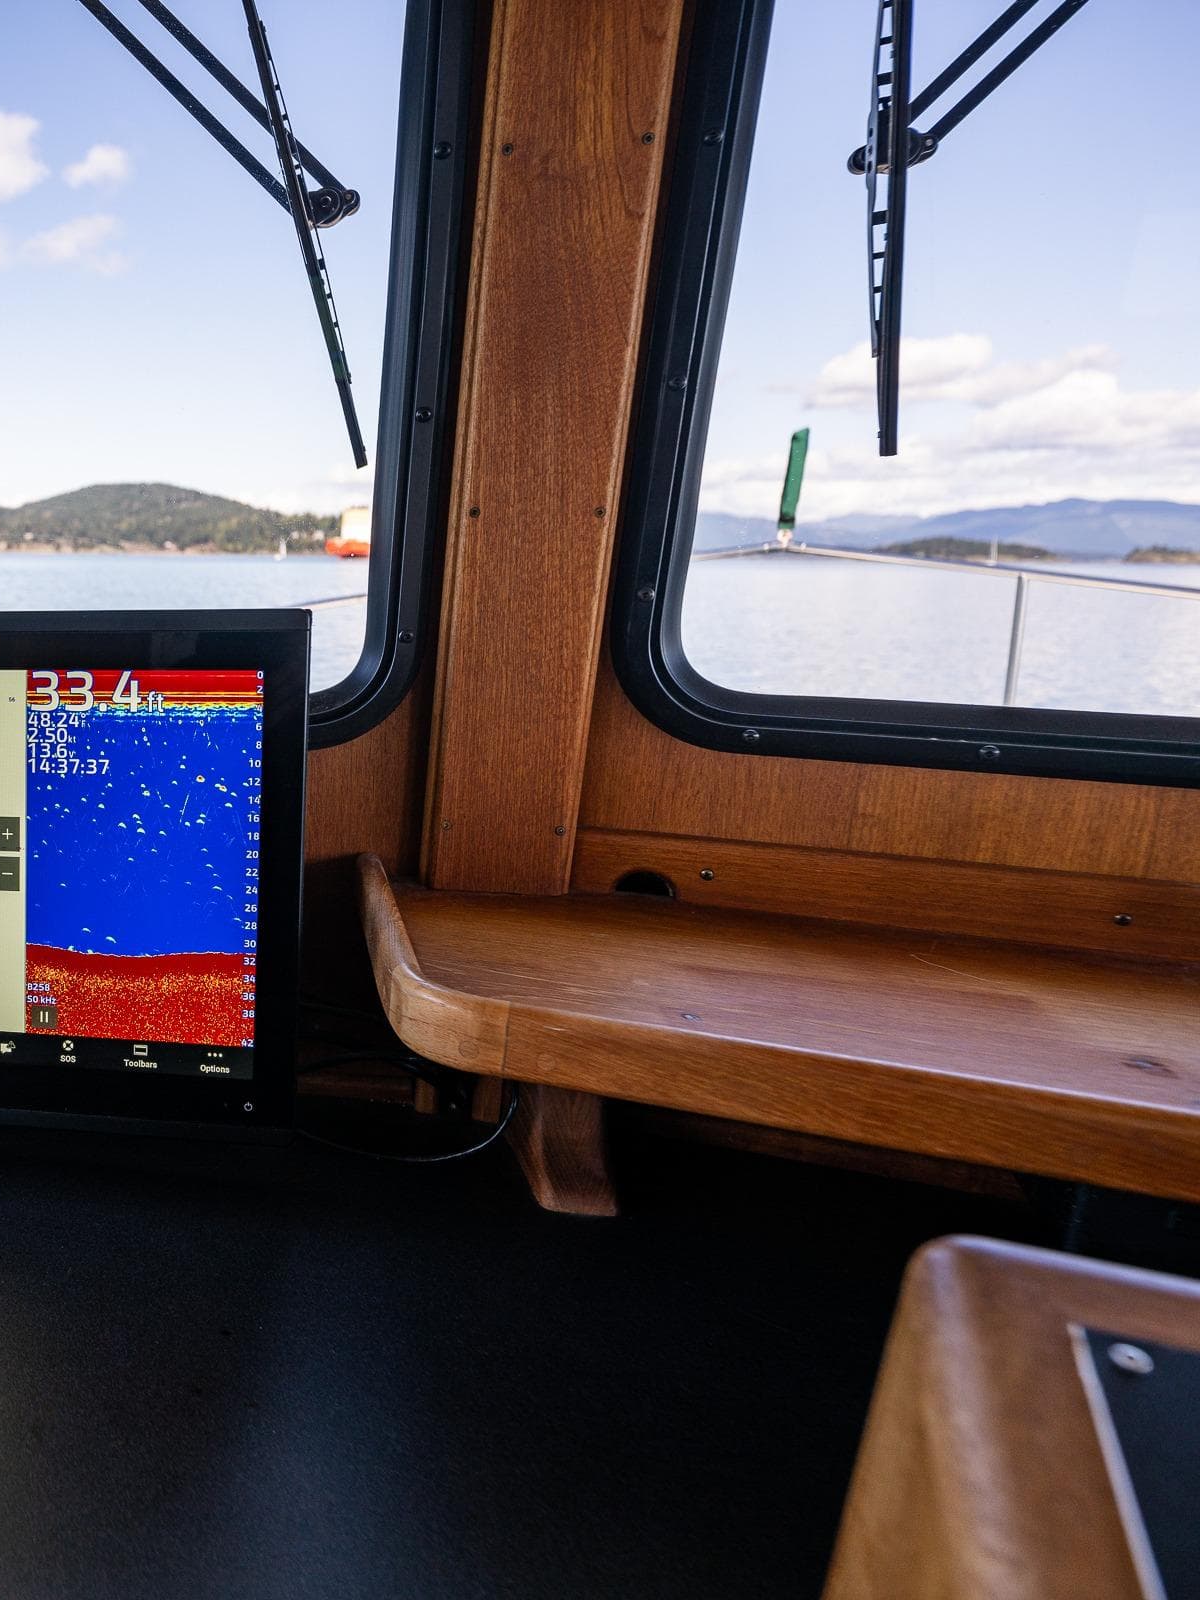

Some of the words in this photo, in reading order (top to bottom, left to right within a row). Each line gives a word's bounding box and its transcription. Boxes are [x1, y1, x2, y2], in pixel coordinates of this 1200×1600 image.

[256, 670, 264, 680] 0
[256, 685, 264, 695] 2
[255, 723, 262, 732] 6
[255, 741, 262, 750] 8
[28, 758, 110, 775] 14:37:37
[249, 759, 261, 768] 10
[248, 777, 261, 786] 12
[248, 796, 260, 805] 14
[247, 814, 260, 823] 16
[247, 832, 260, 841] 18
[246, 850, 259, 859] 20
[245, 868, 259, 877] 22
[245, 885, 258, 895] 24
[244, 903, 257, 913] 26
[244, 921, 257, 930] 28
[243, 939, 257, 948] 30
[243, 957, 256, 966] 32
[243, 974, 256, 983] 34
[27, 995, 39, 1003] 50
[40, 996, 57, 1005] kHz
[242, 992, 255, 1001] 36
[242, 1010, 255, 1018] 38
[241, 1038, 254, 1048] 42
[60, 1054, 77, 1063] SOS
[123, 1058, 158, 1069] Toolbars
[200, 1064, 230, 1074] Options
